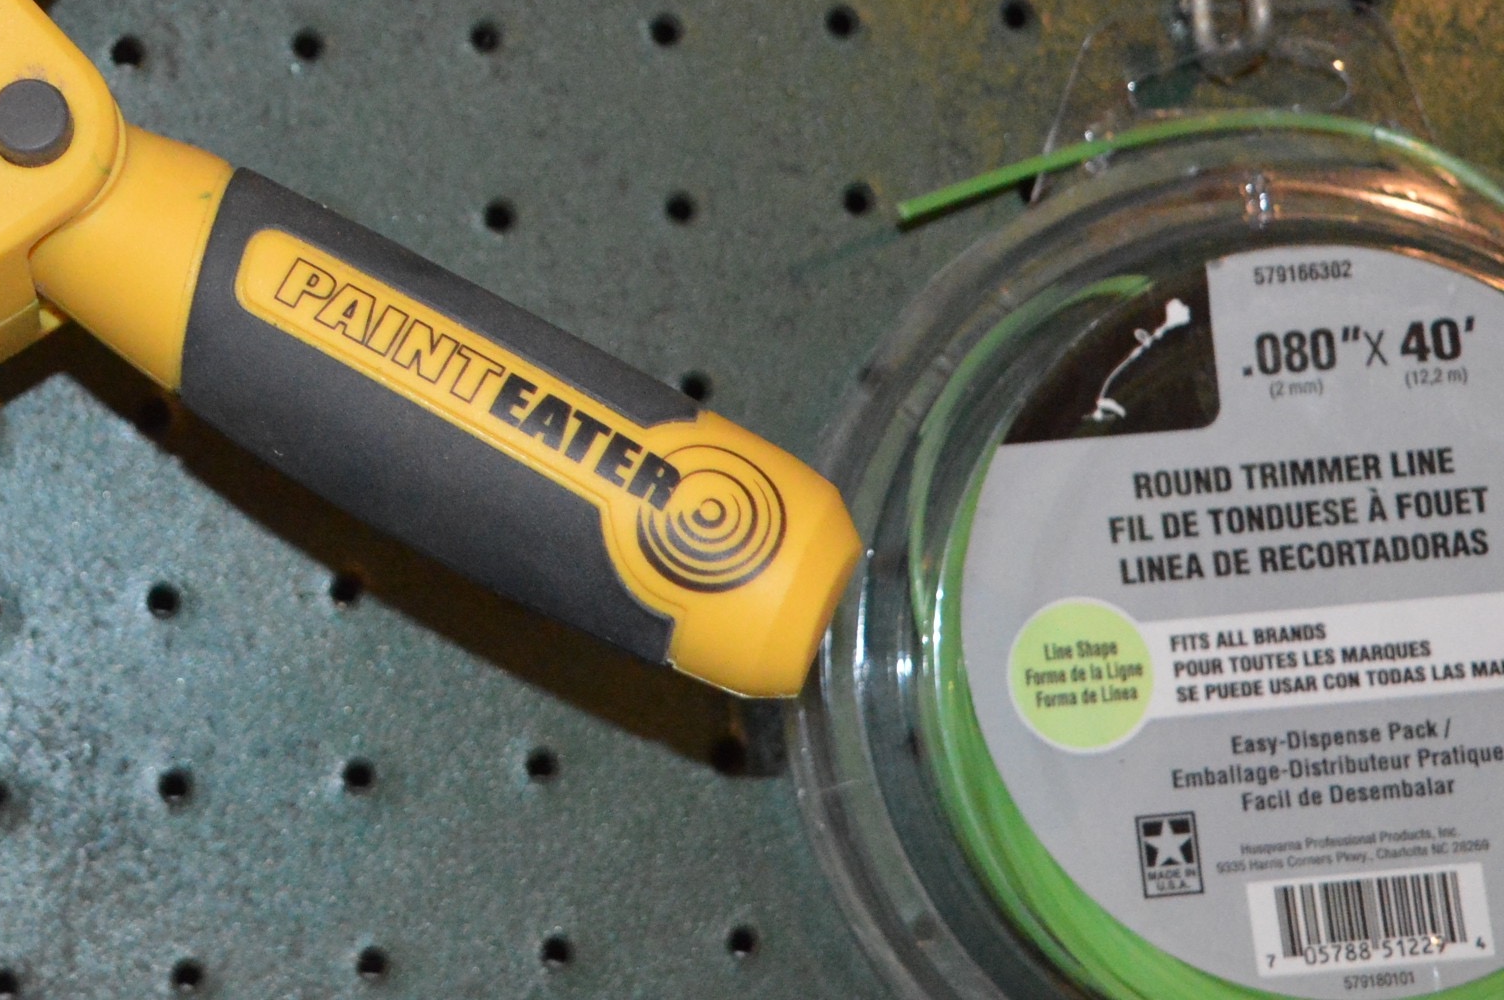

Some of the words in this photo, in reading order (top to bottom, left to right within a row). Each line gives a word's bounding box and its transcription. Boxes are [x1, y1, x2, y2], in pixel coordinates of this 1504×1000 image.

[1254, 260, 1353, 286] 579166302
[1400, 316, 1475, 363] 40'
[1269, 380, 1284, 400] (2
[1288, 377, 1324, 397] mm)
[1446, 367, 1468, 386] m)
[1133, 466, 1233, 500] ROUND
[1241, 454, 1382, 491] TRIMMER
[1390, 447, 1455, 478] LINE
[1108, 514, 1153, 544] FIL
[1163, 510, 1199, 540] DE
[1208, 497, 1359, 537] TONDUESE
[1368, 489, 1388, 522] À
[1397, 486, 1488, 521] FOUET
[1120, 552, 1205, 586] LINEA
[1214, 549, 1251, 578] DE
[1260, 528, 1489, 574] RECORTADORAS
[1043, 642, 1073, 661] Line
[1076, 640, 1118, 660] Shape
[1170, 632, 1210, 652] FITS
[1216, 627, 1248, 648] ALL
[1253, 622, 1327, 645] BRANDS
[1025, 667, 1067, 686] Forme
[1071, 665, 1087, 682] de
[1091, 663, 1103, 680] la
[1106, 662, 1144, 682] Ligne
[1174, 657, 1223, 678] POUR
[1229, 651, 1297, 673] TOUTES
[1303, 648, 1335, 668] LES
[1342, 640, 1432, 664] MARQUES
[1176, 685, 1198, 703] SE
[1205, 679, 1264, 701] PUEDE
[1269, 674, 1318, 695] USAR
[1323, 671, 1360, 690] CON
[1366, 664, 1426, 687] TODAS
[1432, 661, 1466, 681] LAS
[1472, 657, 1504, 677] MA
[1035, 689, 1078, 708] Forma
[1081, 687, 1097, 704] de
[1231, 726, 1382, 755] Easy-Dispense
[1388, 719, 1438, 741] Pack
[1171, 753, 1411, 789] Emballage-Distributeur
[1417, 744, 1504, 768] Pratique
[1241, 790, 1292, 812] Facil
[1298, 787, 1323, 806] de
[1330, 777, 1456, 804] Desembalar
[1305, 832, 1377, 849] Professional
[1438, 826, 1460, 838] Inc.
[1248, 857, 1284, 872] Harris
[1287, 853, 1333, 868] Corners
[1376, 844, 1428, 860] Charlotte
[1432, 842, 1449, 854] NC
[1147, 869, 1181, 881] MADE
[1185, 868, 1196, 877] IN
[1267, 954, 1276, 968] 7
[1304, 942, 1371, 966] 05788
[1343, 971, 1415, 990] 579180101
